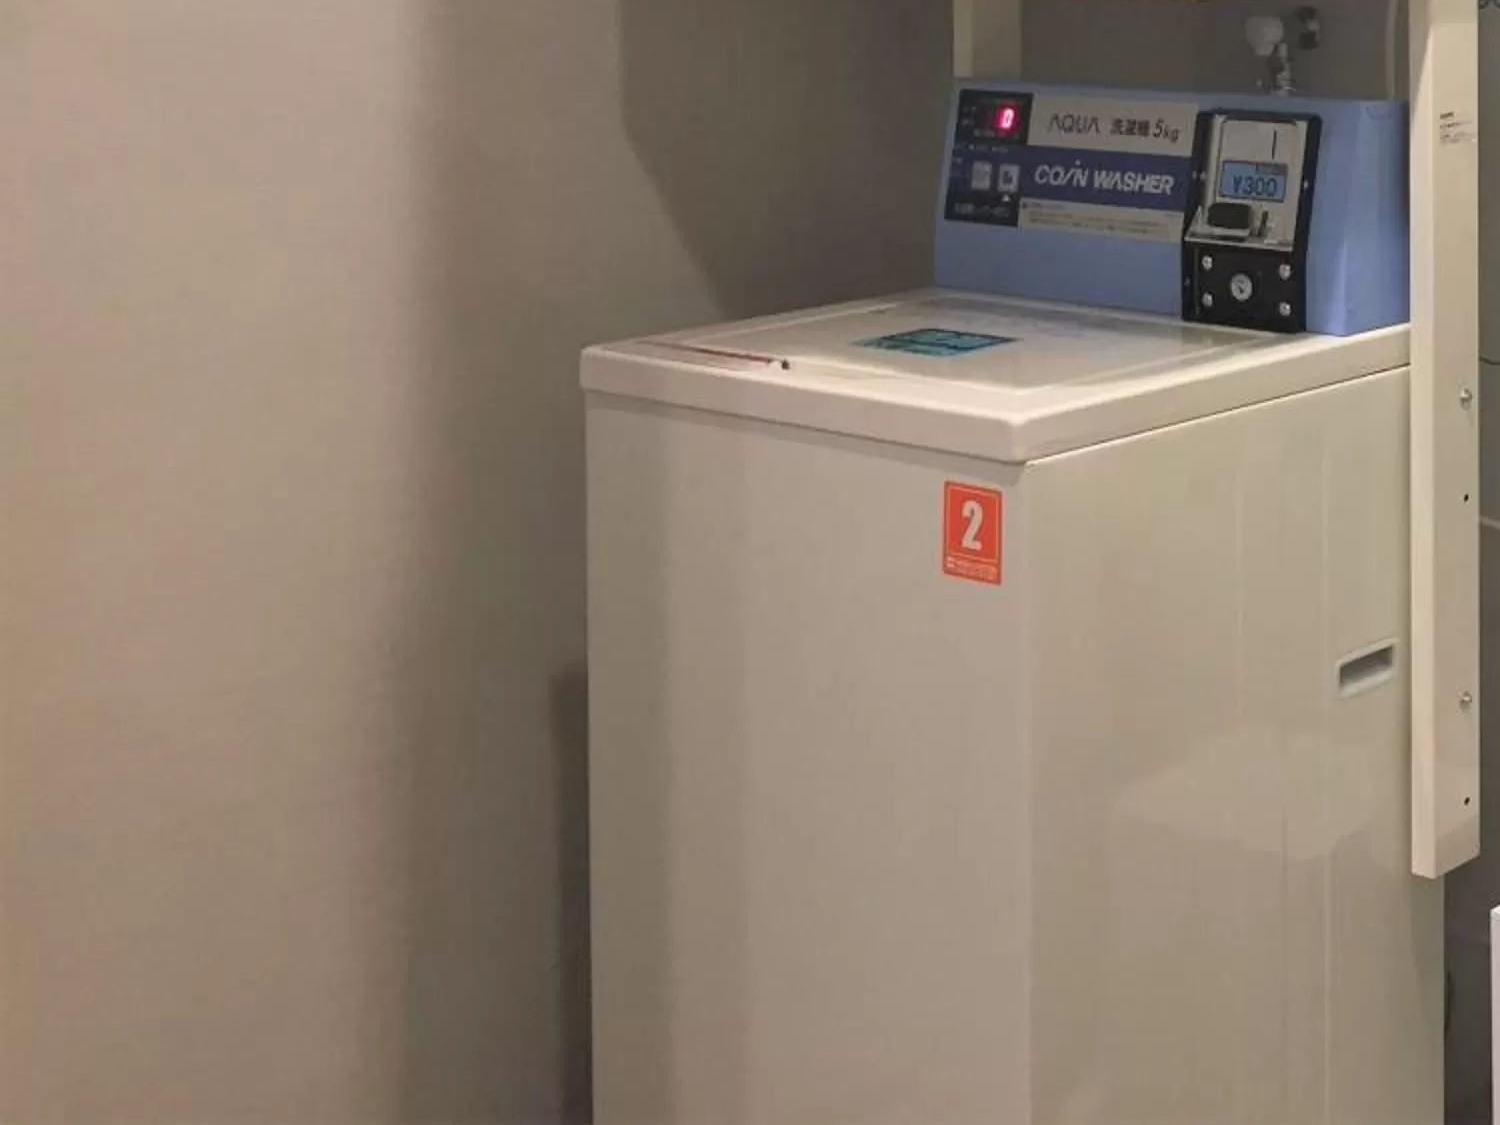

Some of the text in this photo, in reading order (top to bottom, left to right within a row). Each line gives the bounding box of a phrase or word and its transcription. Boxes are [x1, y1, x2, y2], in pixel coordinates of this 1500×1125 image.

[1003, 108, 1015, 129] 0
[1048, 114, 1100, 133] AQUA
[1093, 169, 1175, 196] WASHER
[962, 500, 983, 551] 2
